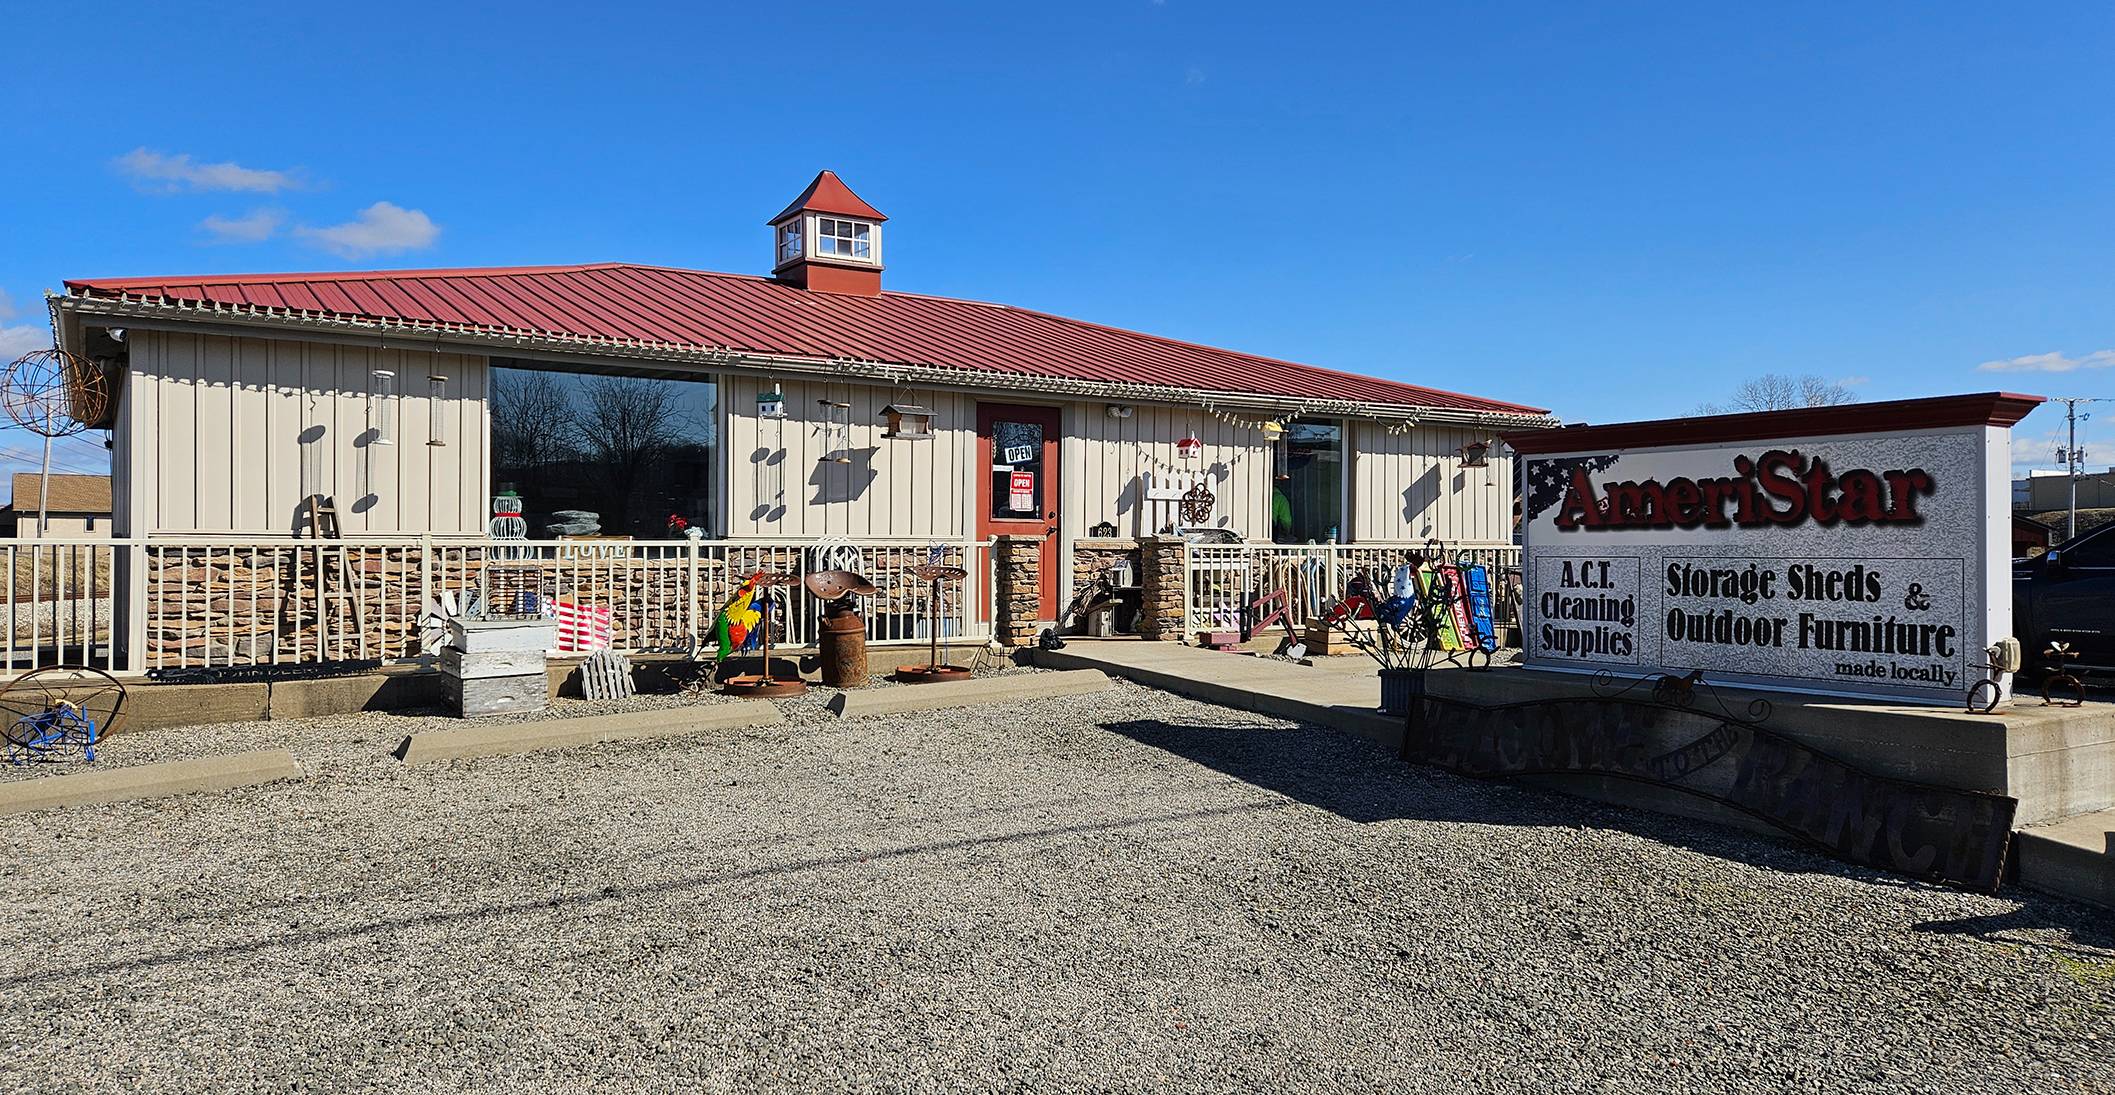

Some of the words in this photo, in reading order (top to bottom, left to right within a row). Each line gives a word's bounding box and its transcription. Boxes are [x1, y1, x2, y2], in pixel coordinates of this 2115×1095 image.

[1008, 446, 1031, 461] OPEN
[1013, 478, 1031, 488] OPEN
[1553, 450, 1933, 530] AmeriStar
[1097, 526, 1113, 538] 623
[1560, 560, 1615, 589] A.C.T.
[1666, 562, 1776, 604] Storage
[1786, 563, 1881, 602] Sheds
[1541, 592, 1635, 628] Cleaning
[1904, 582, 1930, 610] &
[1542, 623, 1632, 657] Supplies
[1667, 608, 1788, 647] Outdoor
[1798, 612, 1956, 657] Furniture
[1834, 660, 1887, 678] made
[1890, 662, 1958, 686] locally
